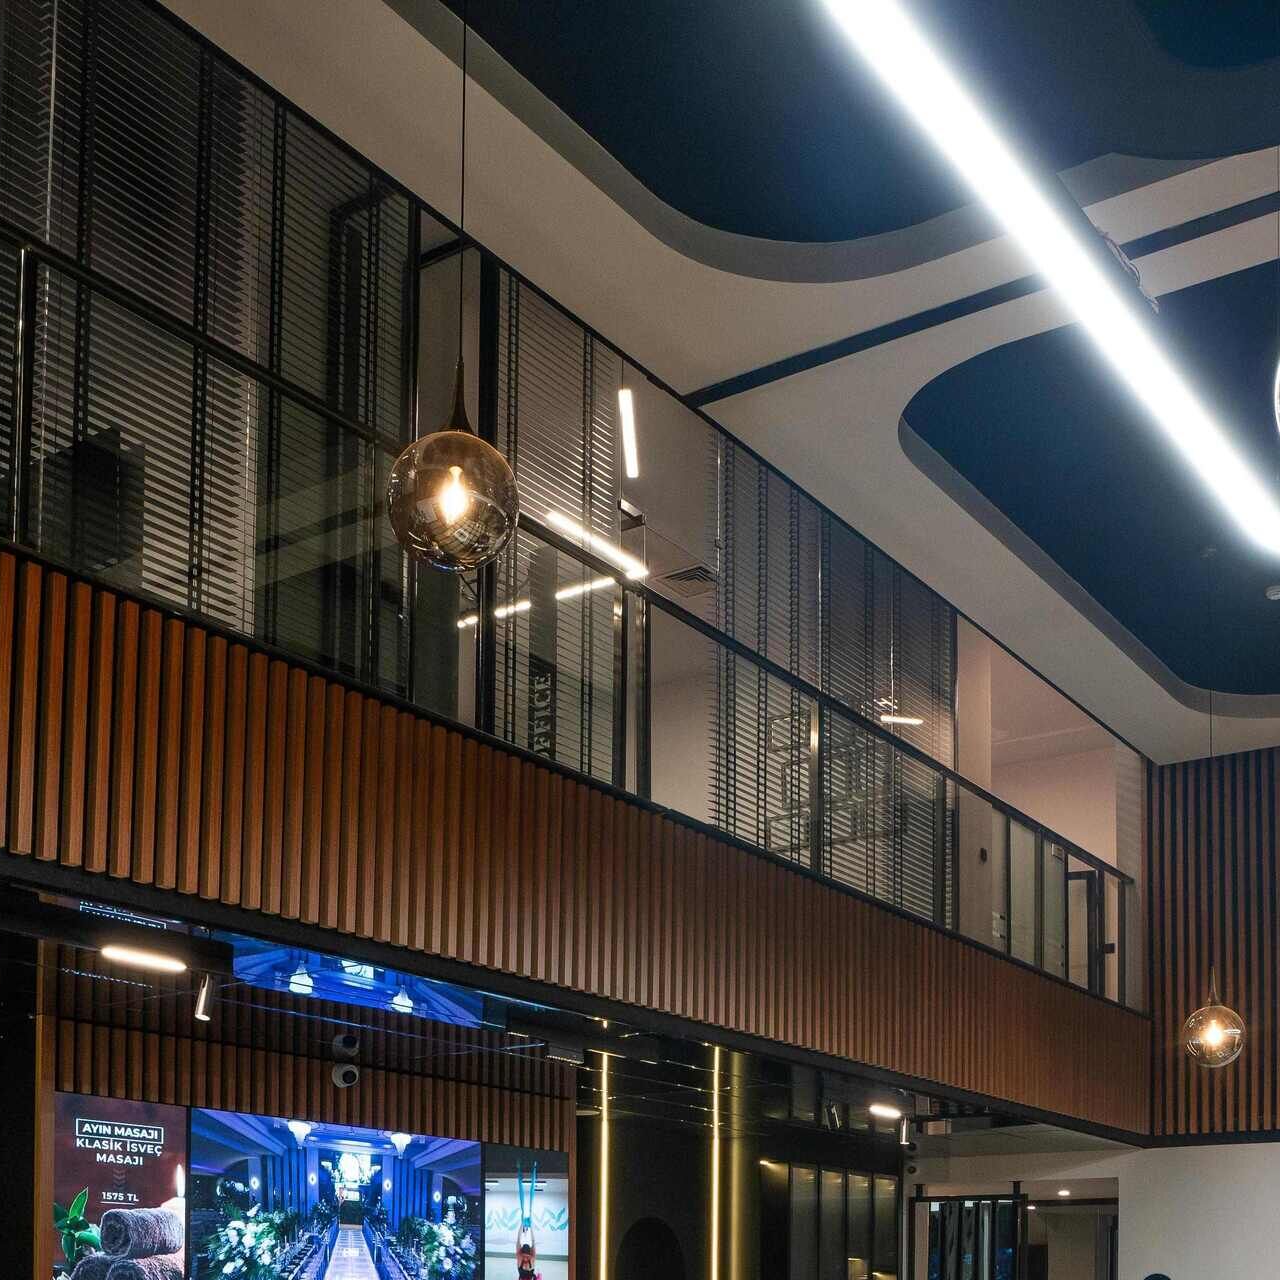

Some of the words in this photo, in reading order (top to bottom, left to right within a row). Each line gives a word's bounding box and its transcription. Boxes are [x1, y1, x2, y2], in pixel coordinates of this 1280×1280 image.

[82, 1123, 112, 1135] AYIN
[114, 1126, 158, 1140] MASAJI
[76, 1137, 122, 1152] KLASİK
[127, 1140, 163, 1156] İSVEÇ
[96, 1152, 143, 1166] MASAJI
[102, 1191, 124, 1201] 1575
[127, 1193, 139, 1202] TL
